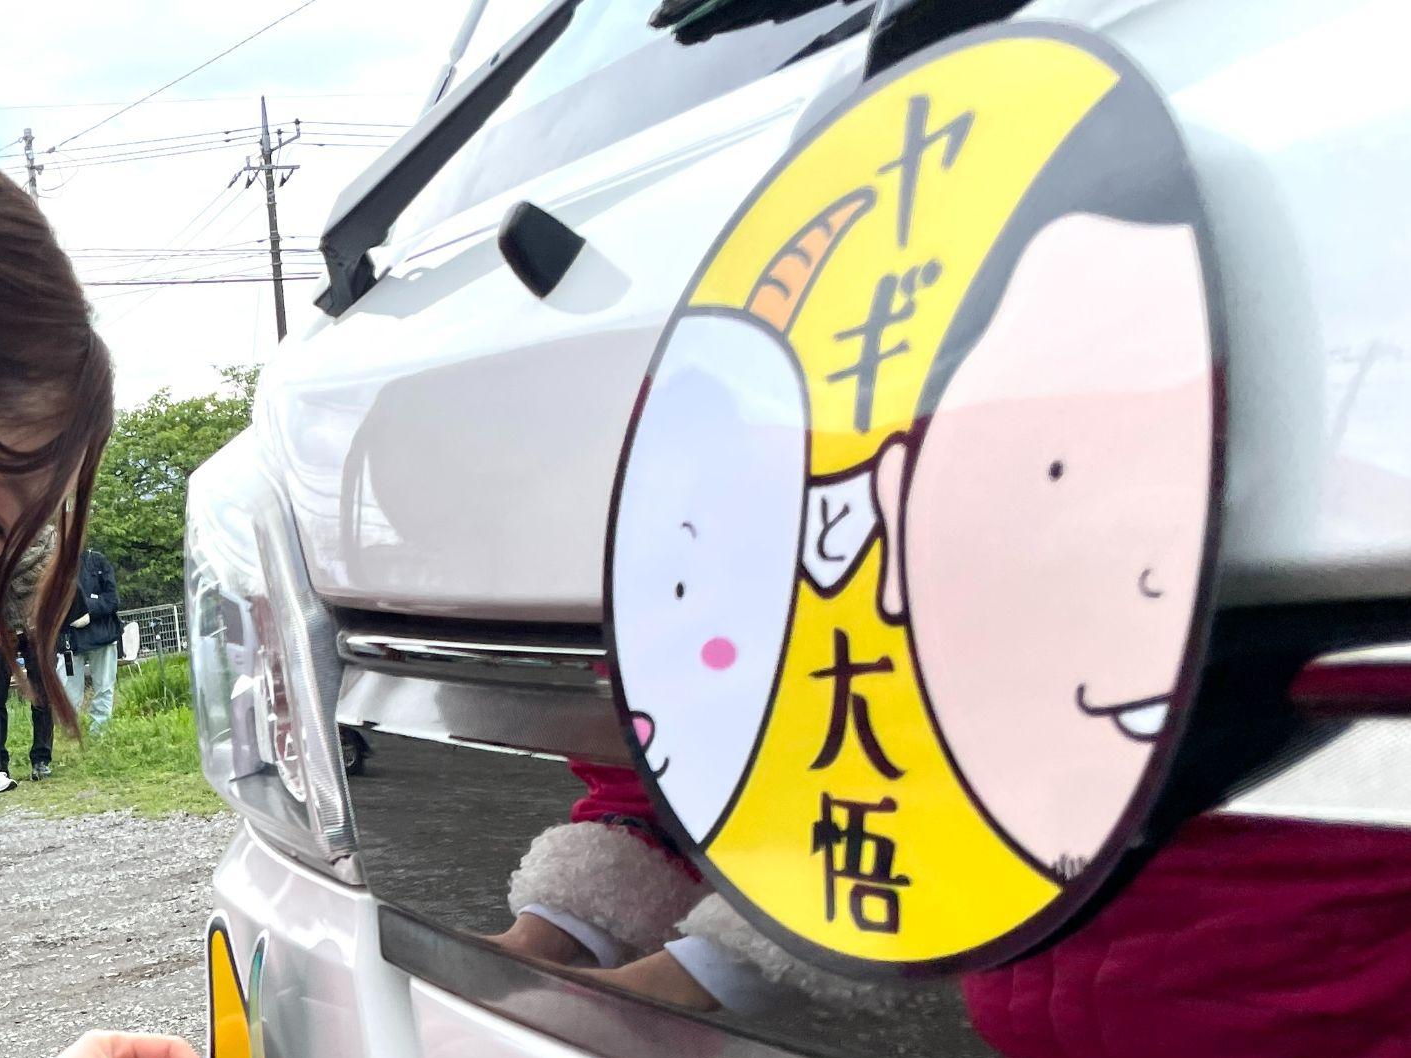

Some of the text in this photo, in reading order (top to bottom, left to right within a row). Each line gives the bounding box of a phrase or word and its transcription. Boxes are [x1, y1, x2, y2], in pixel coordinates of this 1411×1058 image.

[808, 96, 975, 934] ヤギと大悟
